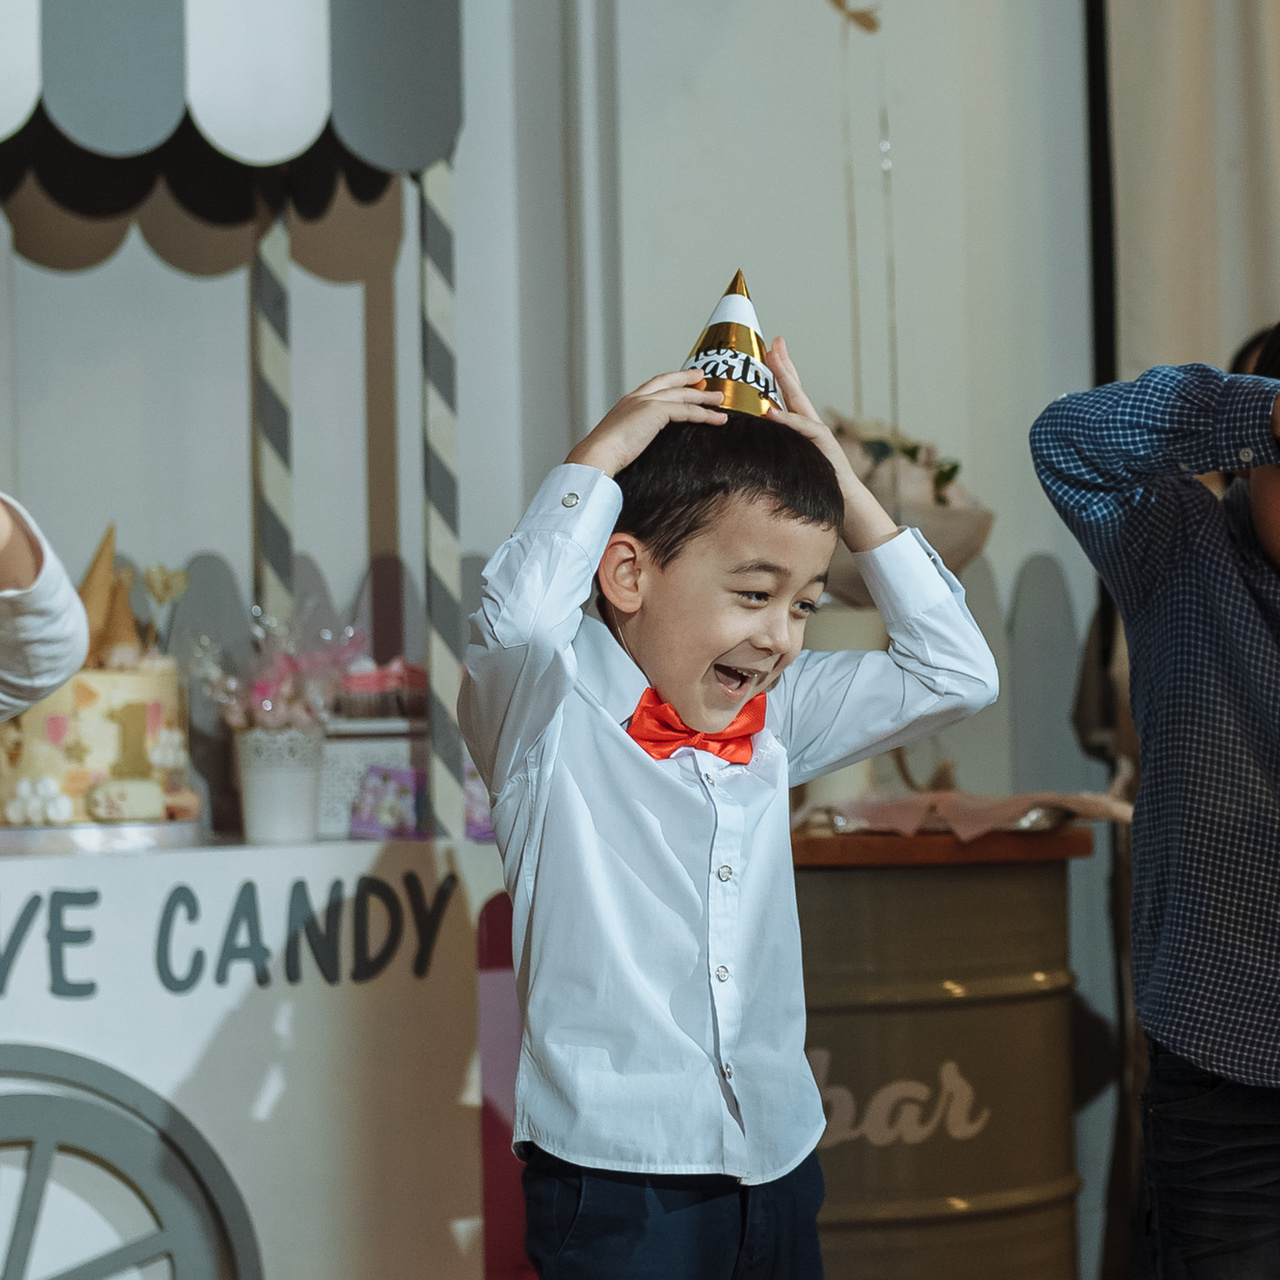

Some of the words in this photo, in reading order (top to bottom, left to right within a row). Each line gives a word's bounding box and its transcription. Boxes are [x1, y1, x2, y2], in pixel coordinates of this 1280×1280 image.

[688, 356, 778, 401] arty!
[155, 870, 459, 995] CANDY
[807, 1049, 993, 1149] bar
